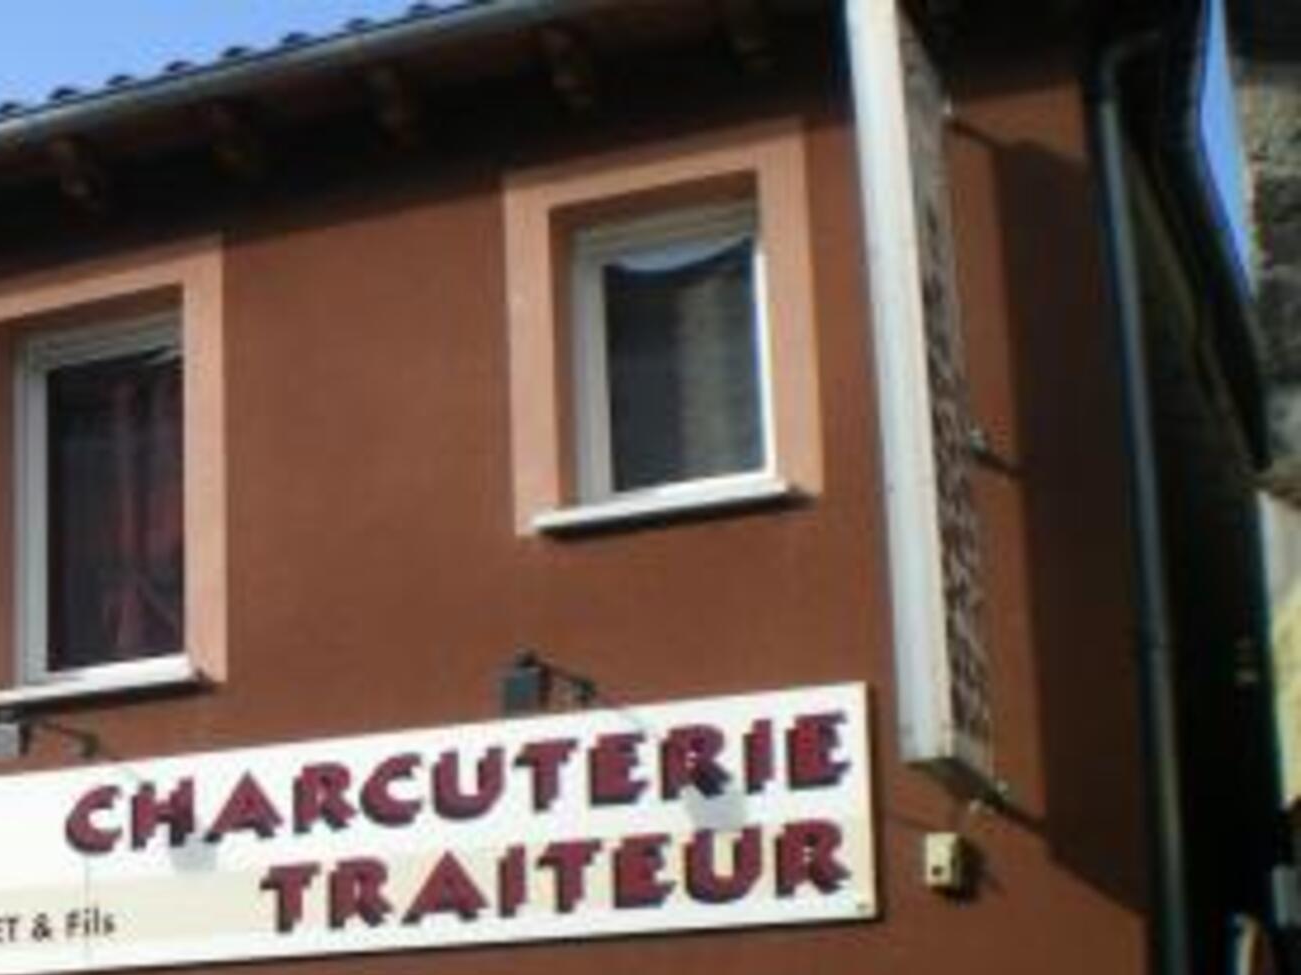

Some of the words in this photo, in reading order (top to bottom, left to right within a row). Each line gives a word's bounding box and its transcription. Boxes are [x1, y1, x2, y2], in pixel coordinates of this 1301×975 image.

[64, 711, 850, 855] CHARCUTERIE
[31, 913, 53, 941] &
[65, 907, 115, 938] Fils
[260, 820, 850, 933] TRAITEUR
